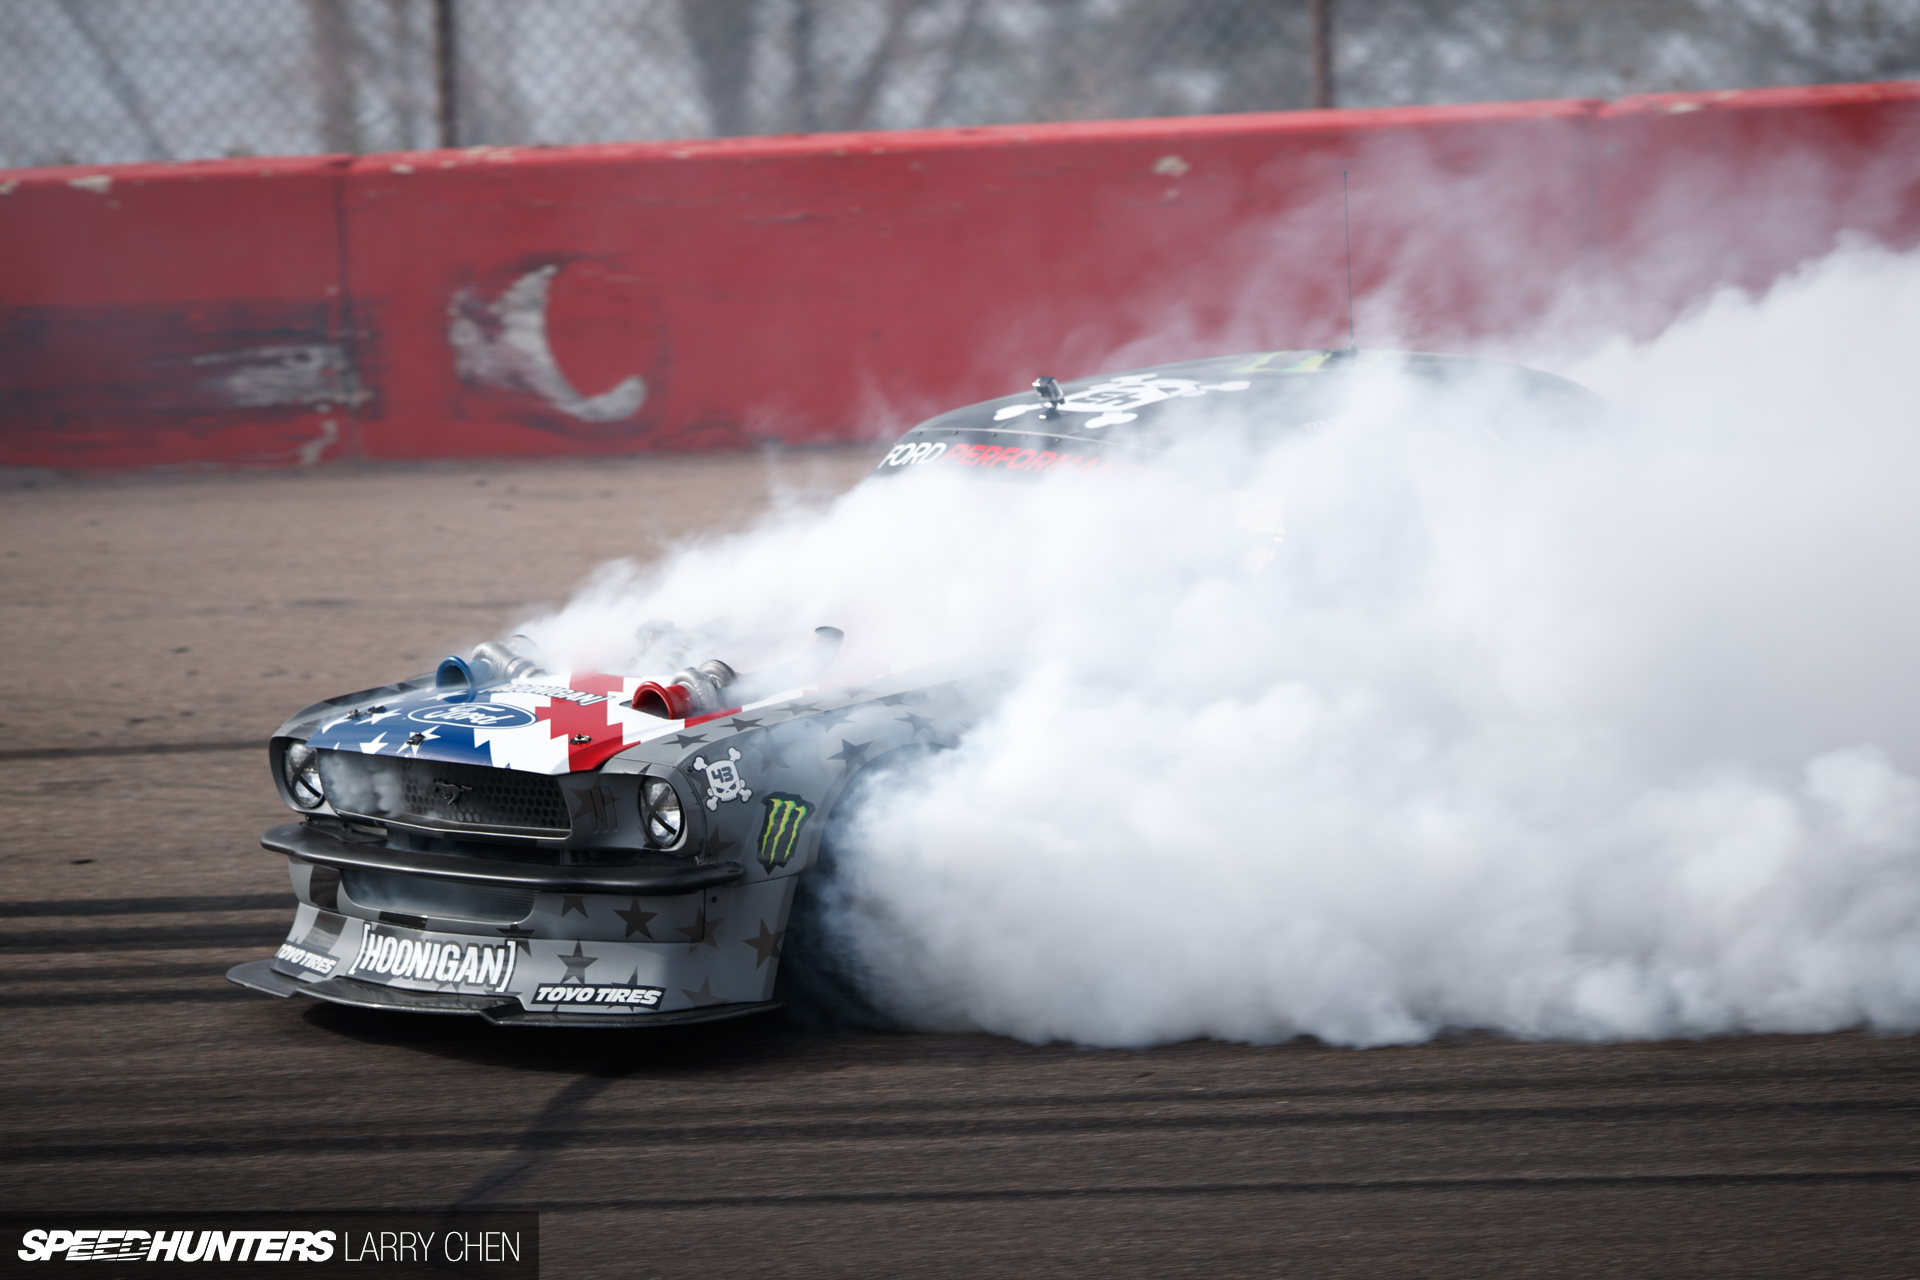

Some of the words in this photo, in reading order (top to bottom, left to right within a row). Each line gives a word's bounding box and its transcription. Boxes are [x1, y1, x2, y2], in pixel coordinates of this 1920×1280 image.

[877, 442, 947, 469] FORD
[423, 704, 516, 725] Ford
[711, 766, 734, 783] 43
[274, 943, 307, 964] TOYO
[299, 951, 338, 974] TIRES
[536, 986, 596, 1003] TOYO
[594, 987, 663, 1006] TIRES
